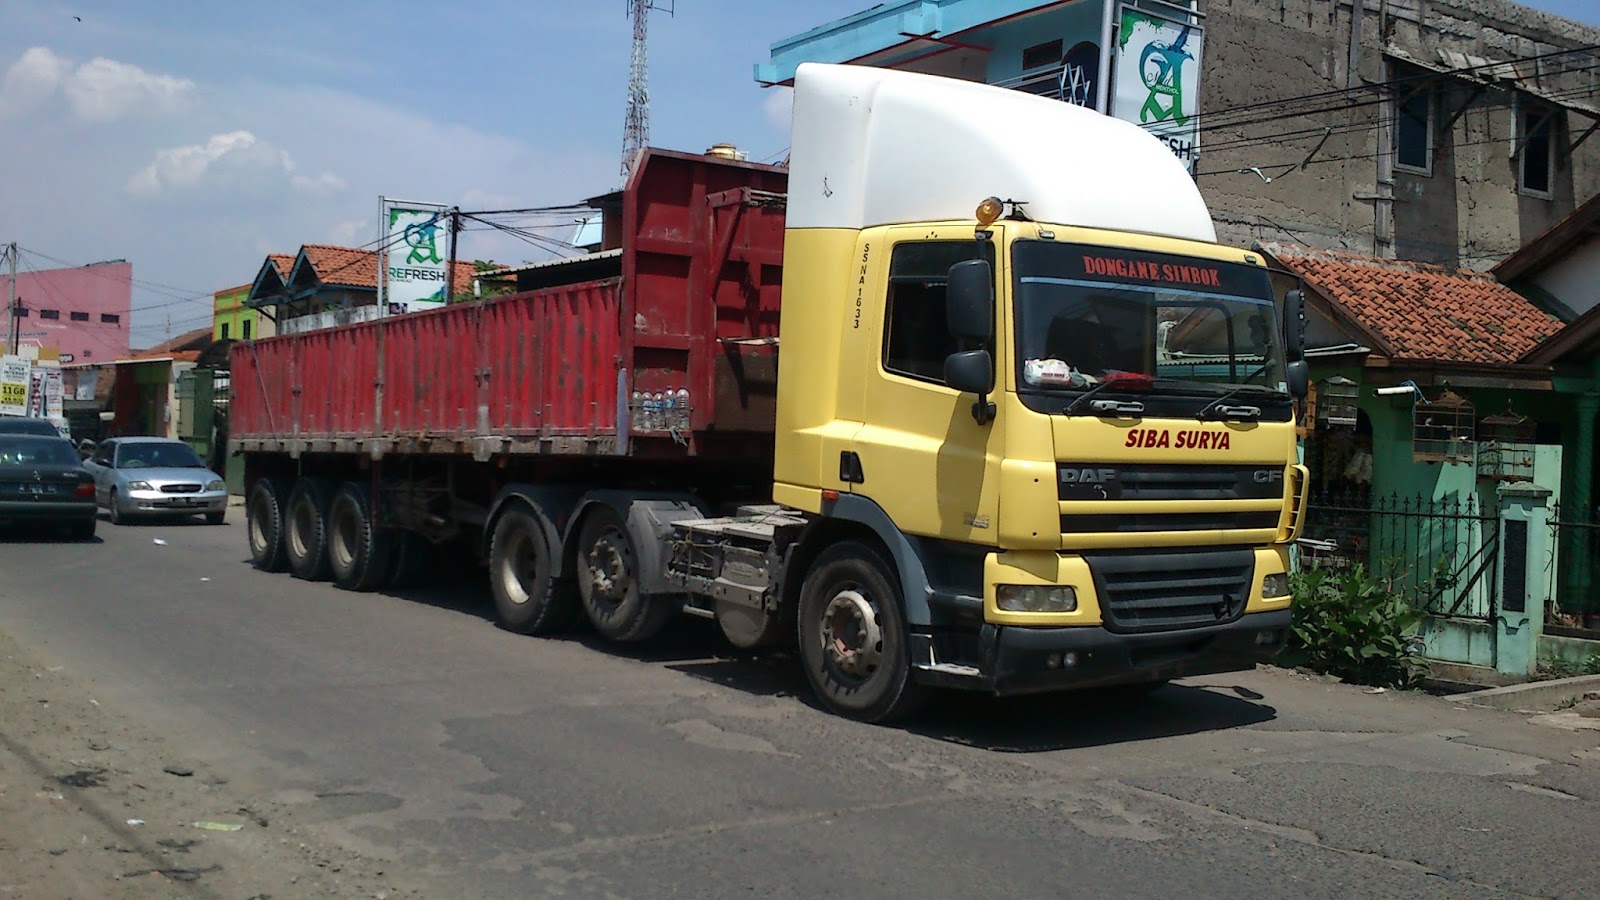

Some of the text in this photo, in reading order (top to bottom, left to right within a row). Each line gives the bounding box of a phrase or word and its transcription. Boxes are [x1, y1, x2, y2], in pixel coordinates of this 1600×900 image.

[389, 267, 445, 281] REFRESH
[1124, 429, 1230, 450] SIBA SURYA
[1059, 468, 1116, 483] DAF
[1253, 469, 1283, 484] CF
